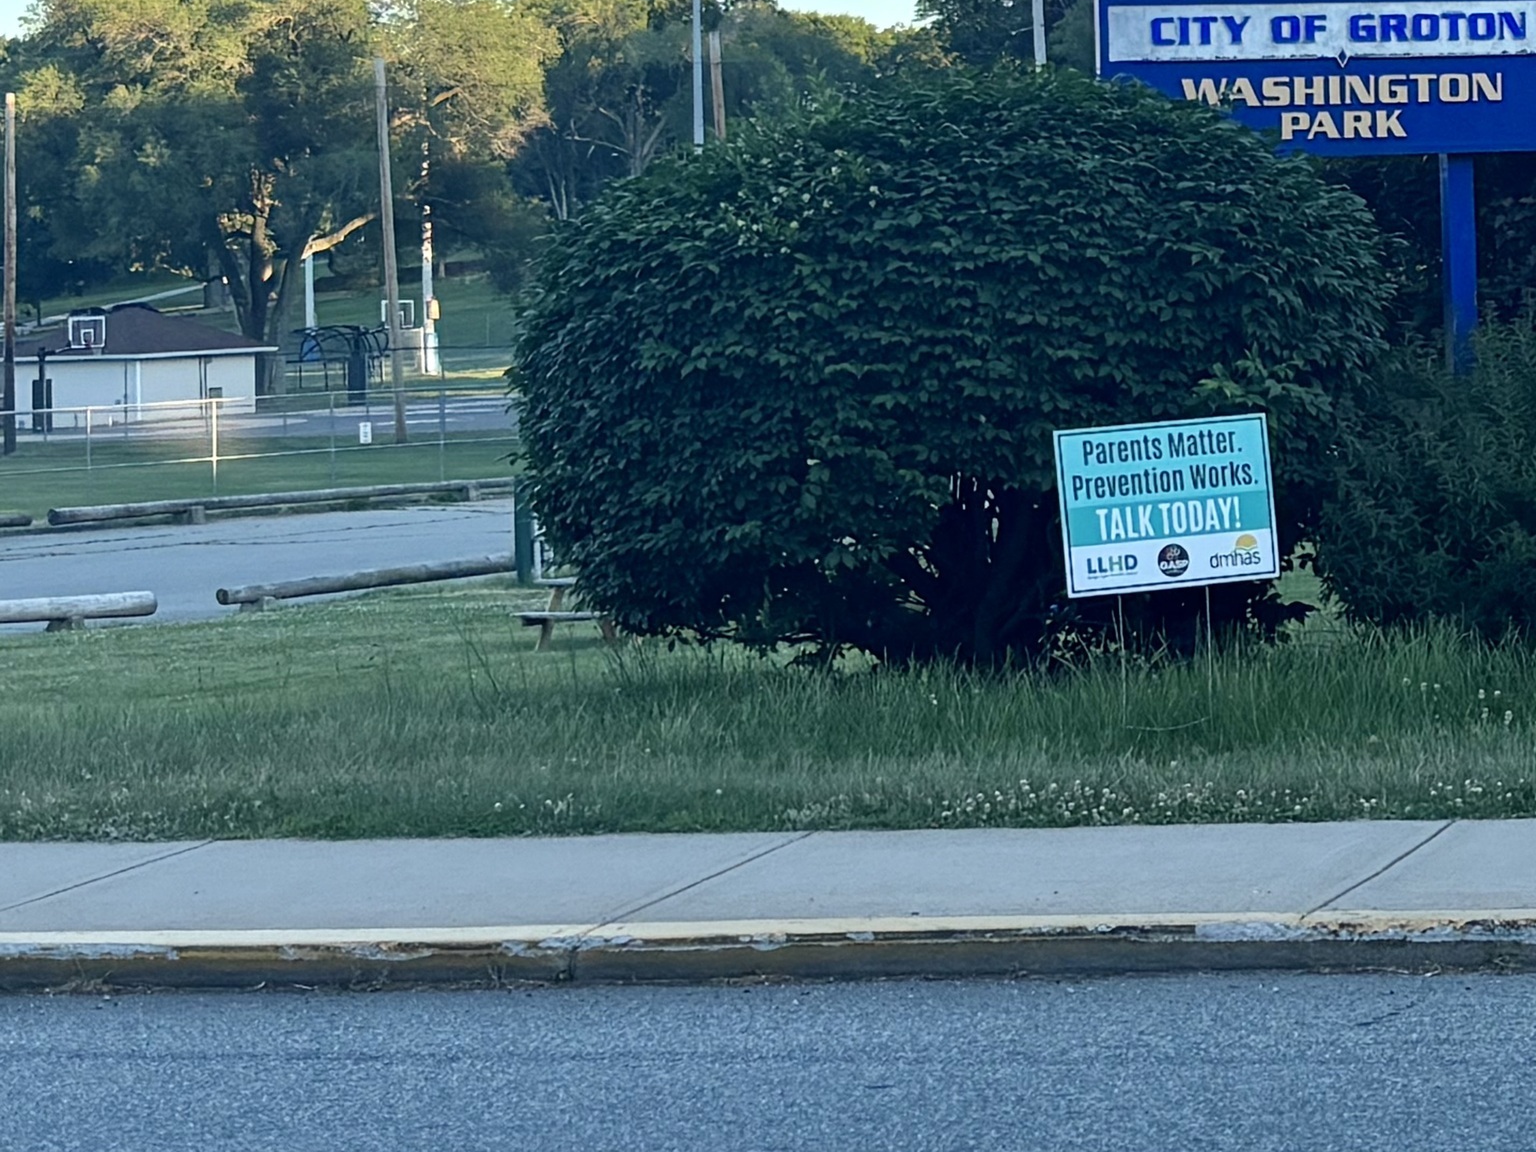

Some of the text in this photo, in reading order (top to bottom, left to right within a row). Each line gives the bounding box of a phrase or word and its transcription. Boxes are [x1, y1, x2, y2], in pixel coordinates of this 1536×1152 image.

[1151, 11, 1527, 46] CITY OF GROTON
[1181, 72, 1503, 108] WASHINGTON
[1281, 109, 1407, 140] PARK
[1082, 429, 1243, 466] Parents Matter.
[1072, 461, 1259, 501] Prevention Works.
[1096, 496, 1242, 541] TALK TODAY!
[1087, 554, 1138, 574] LLHD
[1209, 549, 1261, 569] dmhas
